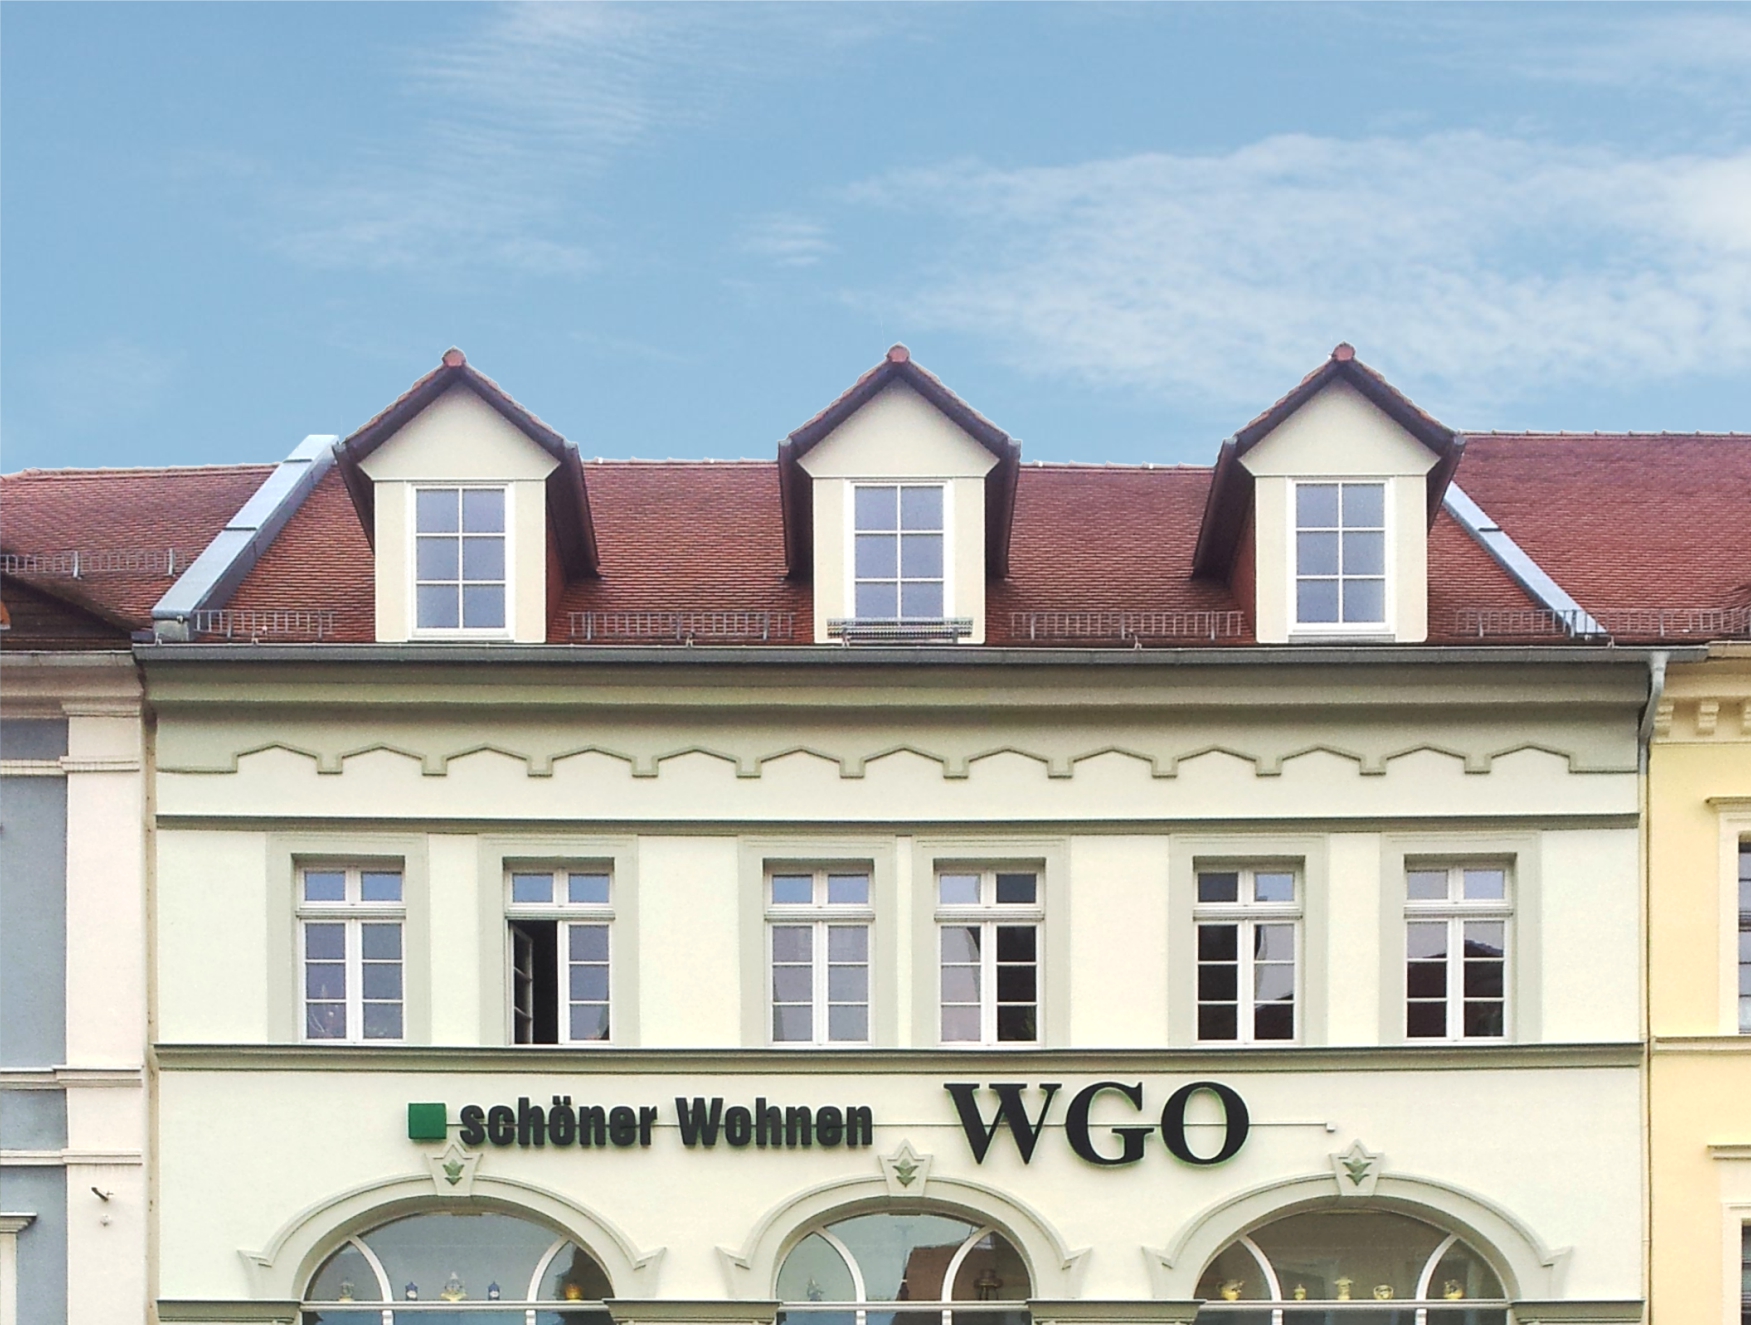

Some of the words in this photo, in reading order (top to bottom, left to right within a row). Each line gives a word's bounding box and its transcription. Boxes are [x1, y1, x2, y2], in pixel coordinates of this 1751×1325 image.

[458, 1096, 657, 1147] schöner
[675, 1096, 873, 1148] Wohnen
[943, 1081, 1251, 1166] WGO
